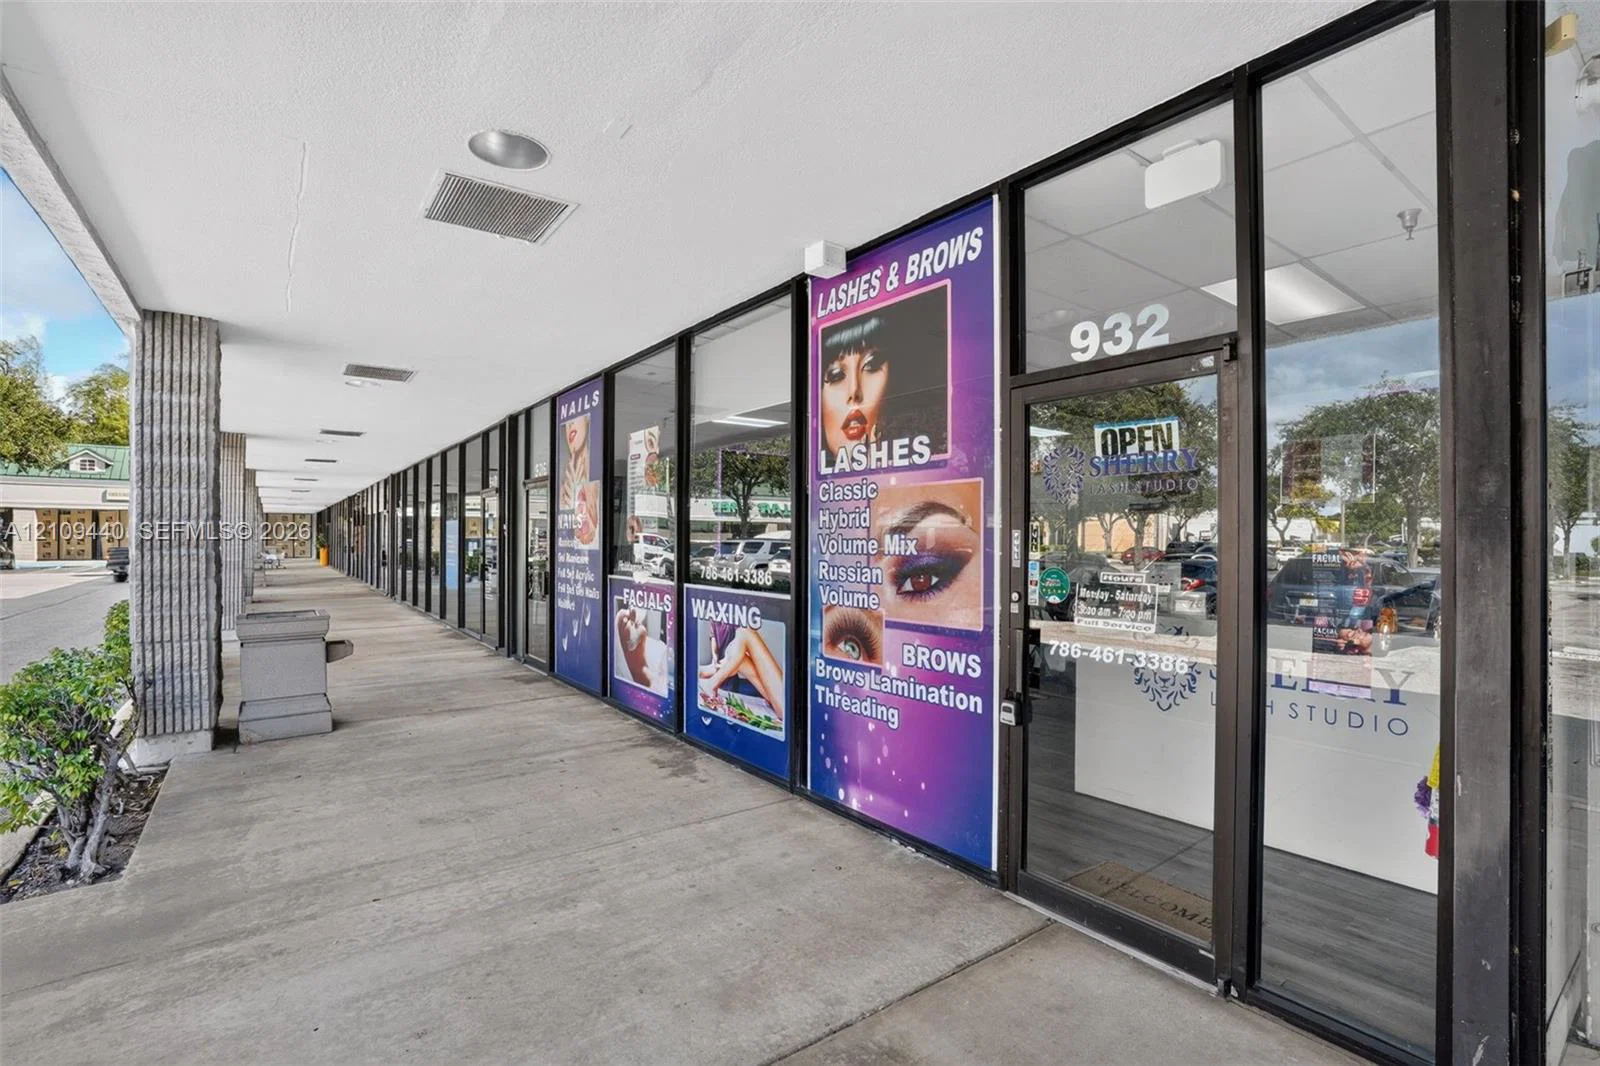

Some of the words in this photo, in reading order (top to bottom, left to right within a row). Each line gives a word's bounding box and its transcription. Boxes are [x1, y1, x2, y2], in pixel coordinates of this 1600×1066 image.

[816, 268, 882, 318] LASHES
[886, 261, 900, 292] &
[904, 226, 984, 286] BROWS
[1069, 303, 1170, 362] 932
[560, 390, 600, 419] NAILS
[1100, 422, 1173, 456] OPEN
[819, 435, 932, 476] LASHES
[1089, 447, 1200, 478] SHERRY
[818, 482, 879, 502] Classic
[558, 513, 584, 530] NAILS
[818, 507, 871, 533] Hybrid
[817, 534, 879, 556] Volume
[883, 533, 918, 556] Mix
[818, 561, 883, 584] Russian
[1103, 573, 1143, 583] Hours
[622, 588, 672, 613] FACIALS
[819, 586, 880, 610] Volume
[1079, 587, 1110, 602] Monday
[1115, 589, 1153, 606] Saturday
[691, 597, 762, 630] WAXING
[1138, 610, 1152, 622] pm
[902, 642, 982, 678] BROWS
[1049, 640, 1189, 674] 786-461-3386
[815, 659, 870, 687] Brows
[870, 669, 983, 714] Lamination
[814, 684, 900, 729] Threading
[1288, 702, 1410, 737] STUDIO
[1096, 874, 1213, 930] WELCOME
